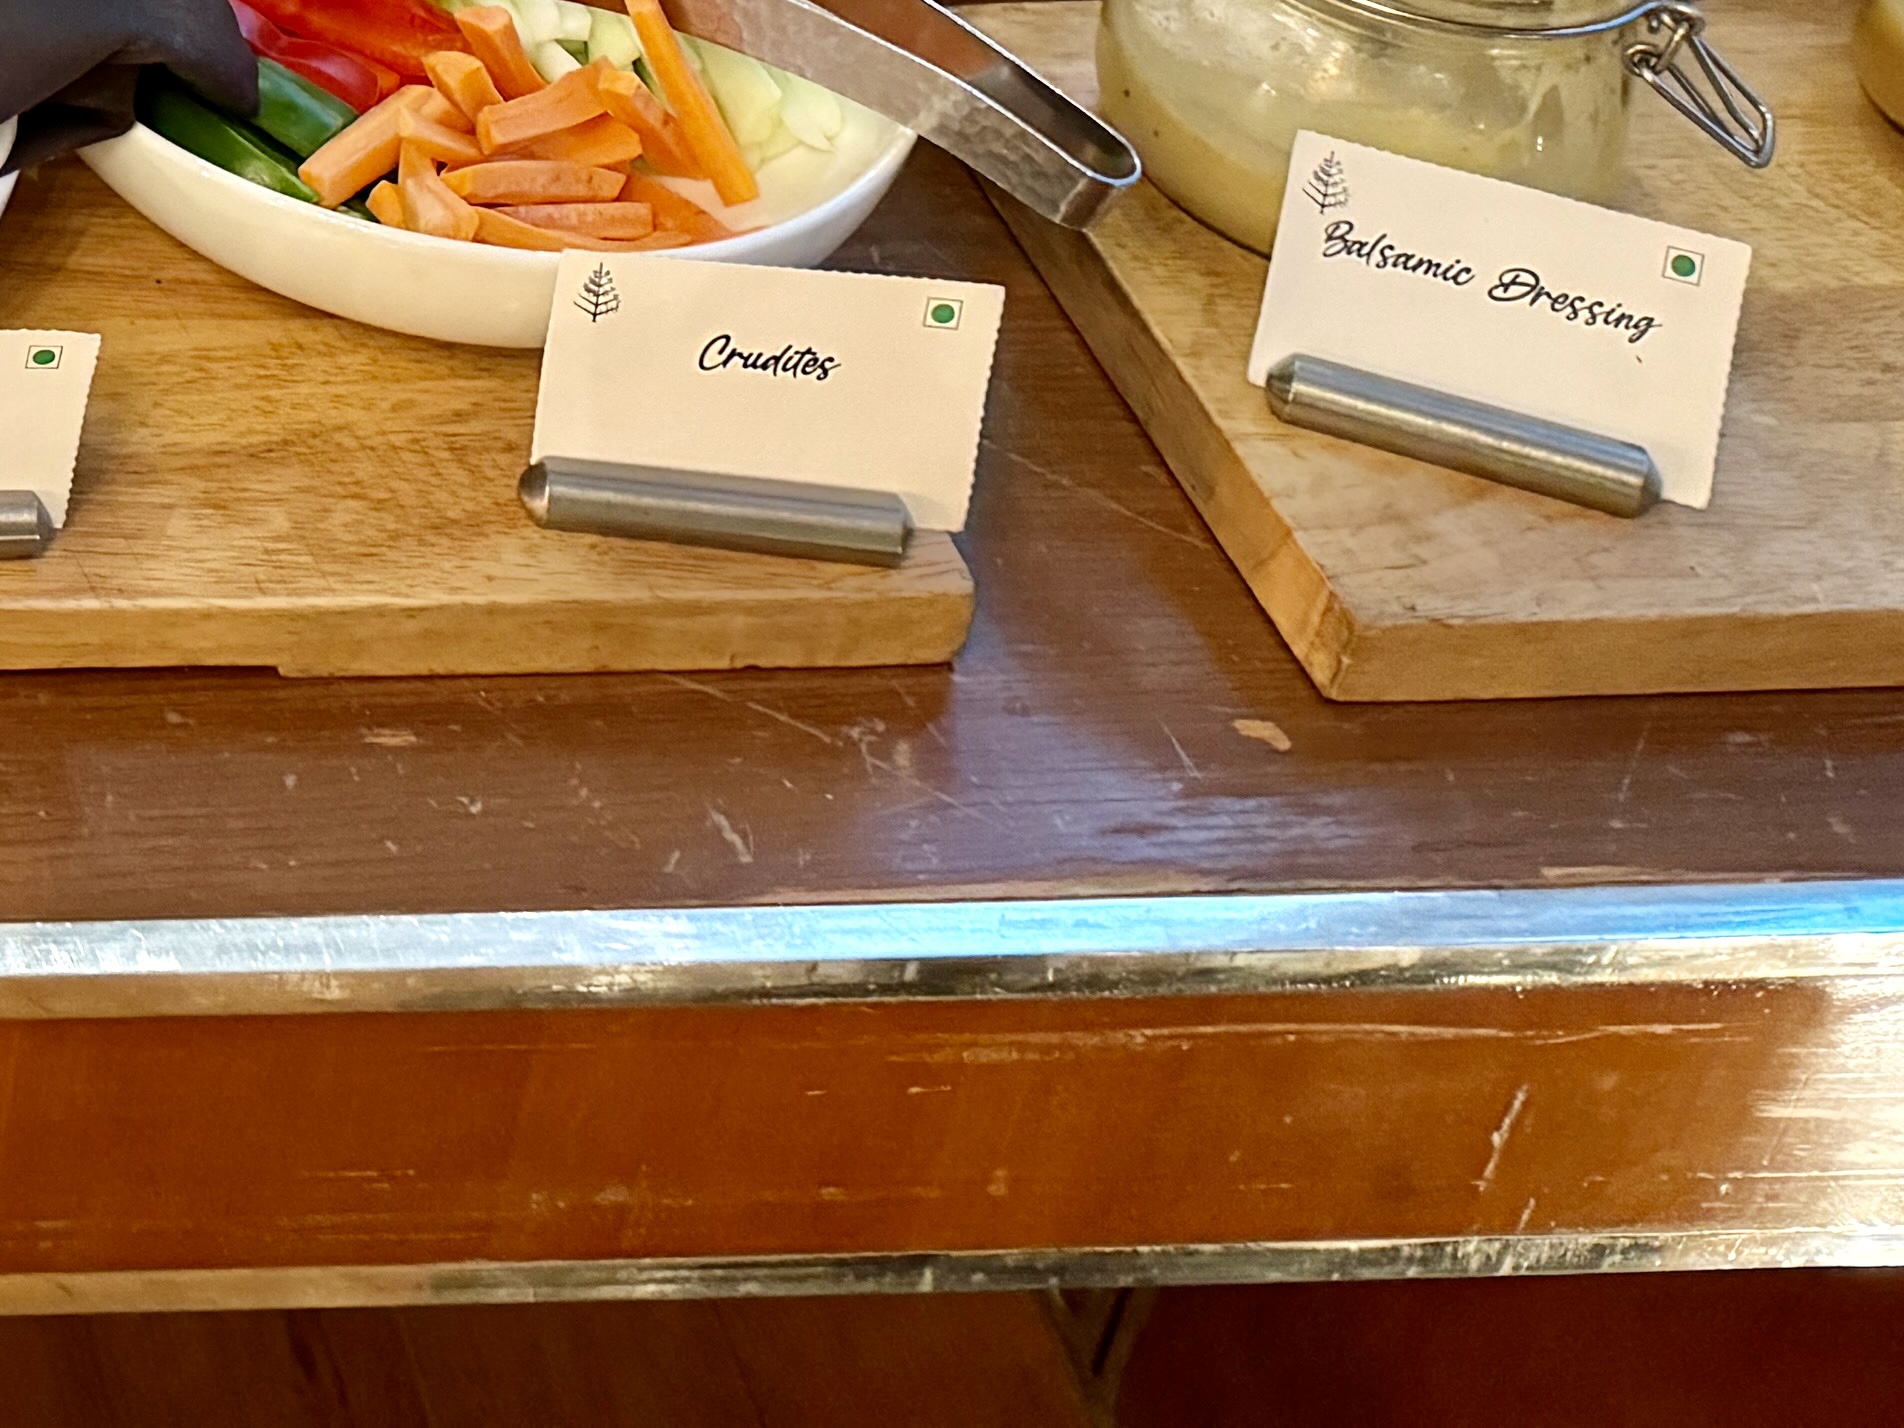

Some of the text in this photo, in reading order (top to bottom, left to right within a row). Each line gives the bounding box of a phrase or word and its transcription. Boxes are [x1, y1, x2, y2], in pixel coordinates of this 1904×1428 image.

[1322, 217, 1663, 344] Balsamic Dressing
[698, 333, 842, 382] Crudites
